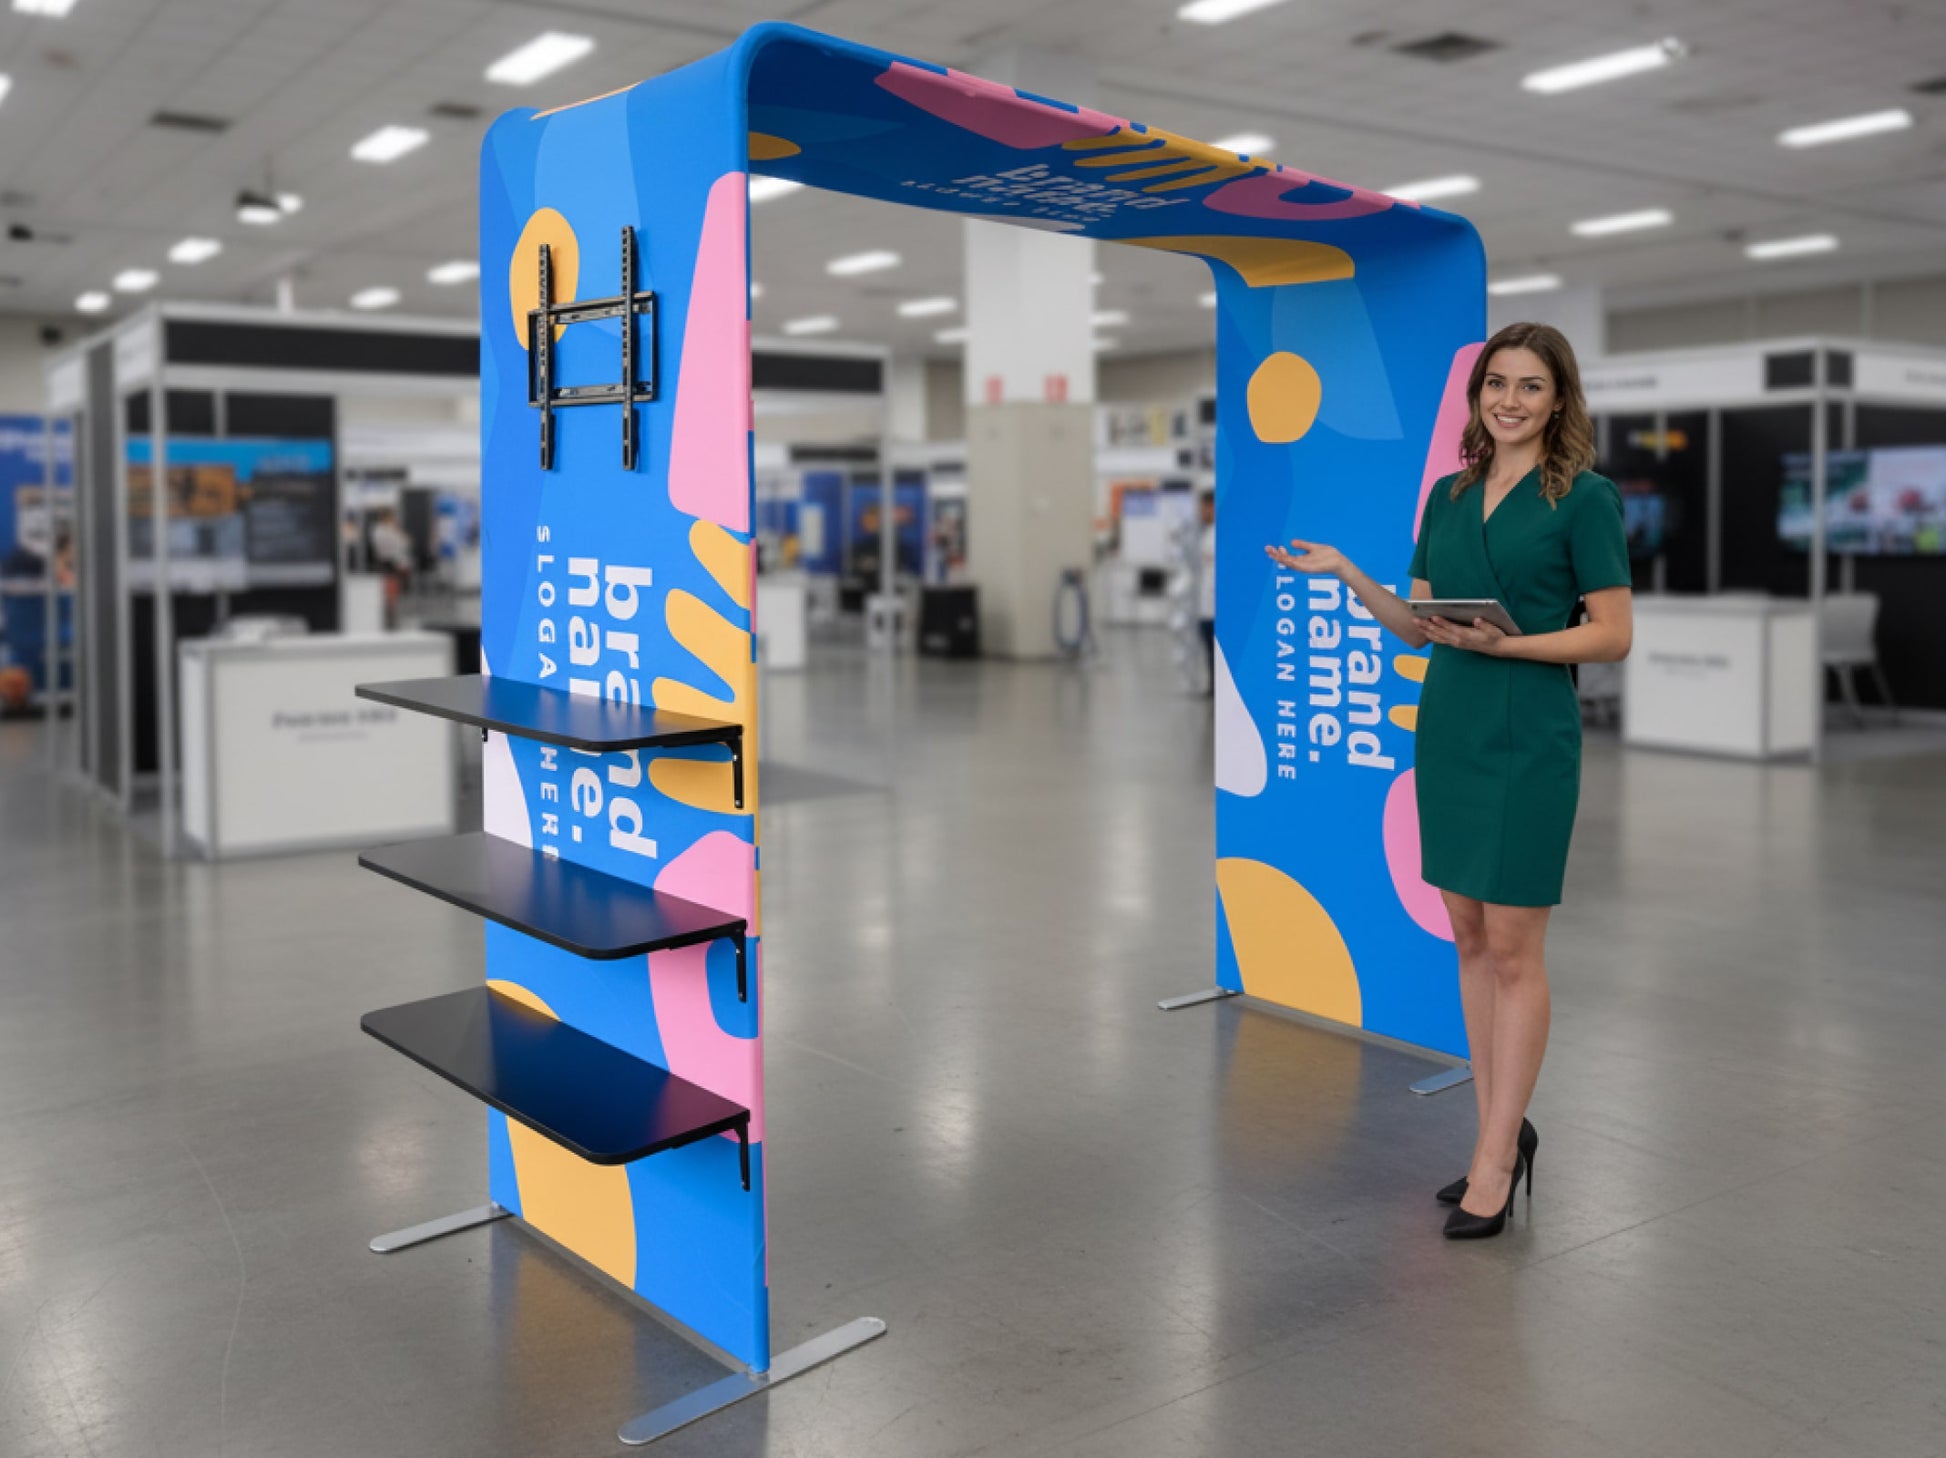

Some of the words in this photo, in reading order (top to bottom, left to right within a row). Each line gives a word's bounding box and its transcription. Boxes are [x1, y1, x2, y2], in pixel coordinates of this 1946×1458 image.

[996, 163, 1191, 210] brand
[536, 525, 557, 679] SLOGA
[1276, 562, 1296, 681] LOGAN
[567, 557, 604, 843] nae.
[1308, 578, 1342, 763] name.
[1277, 700, 1297, 780] HERE
